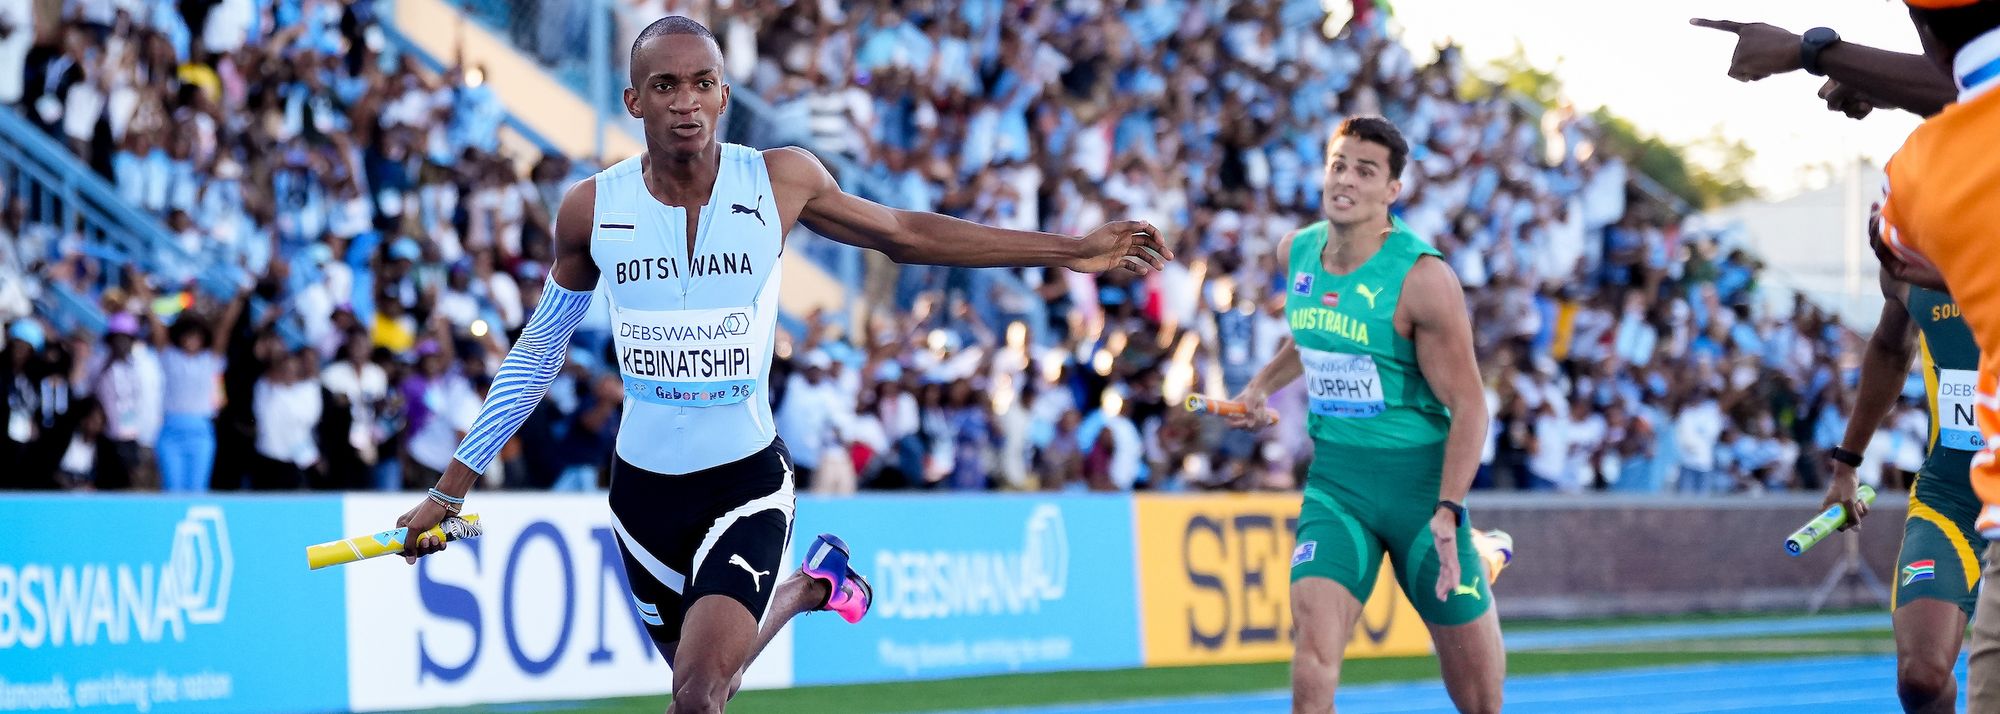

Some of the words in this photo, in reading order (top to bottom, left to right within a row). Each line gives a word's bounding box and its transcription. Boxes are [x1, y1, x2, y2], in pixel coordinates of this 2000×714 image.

[615, 252, 753, 285] BOTSWANA
[620, 322, 728, 342] DEBSWANA
[1291, 307, 1370, 346] AUSTRALIA
[622, 346, 751, 378] KEBINATSHIPI
[655, 384, 726, 401] Gaborone
[731, 384, 750, 398] 26
[1307, 375, 1374, 399] MURPHY
[417, 520, 655, 687] SON
